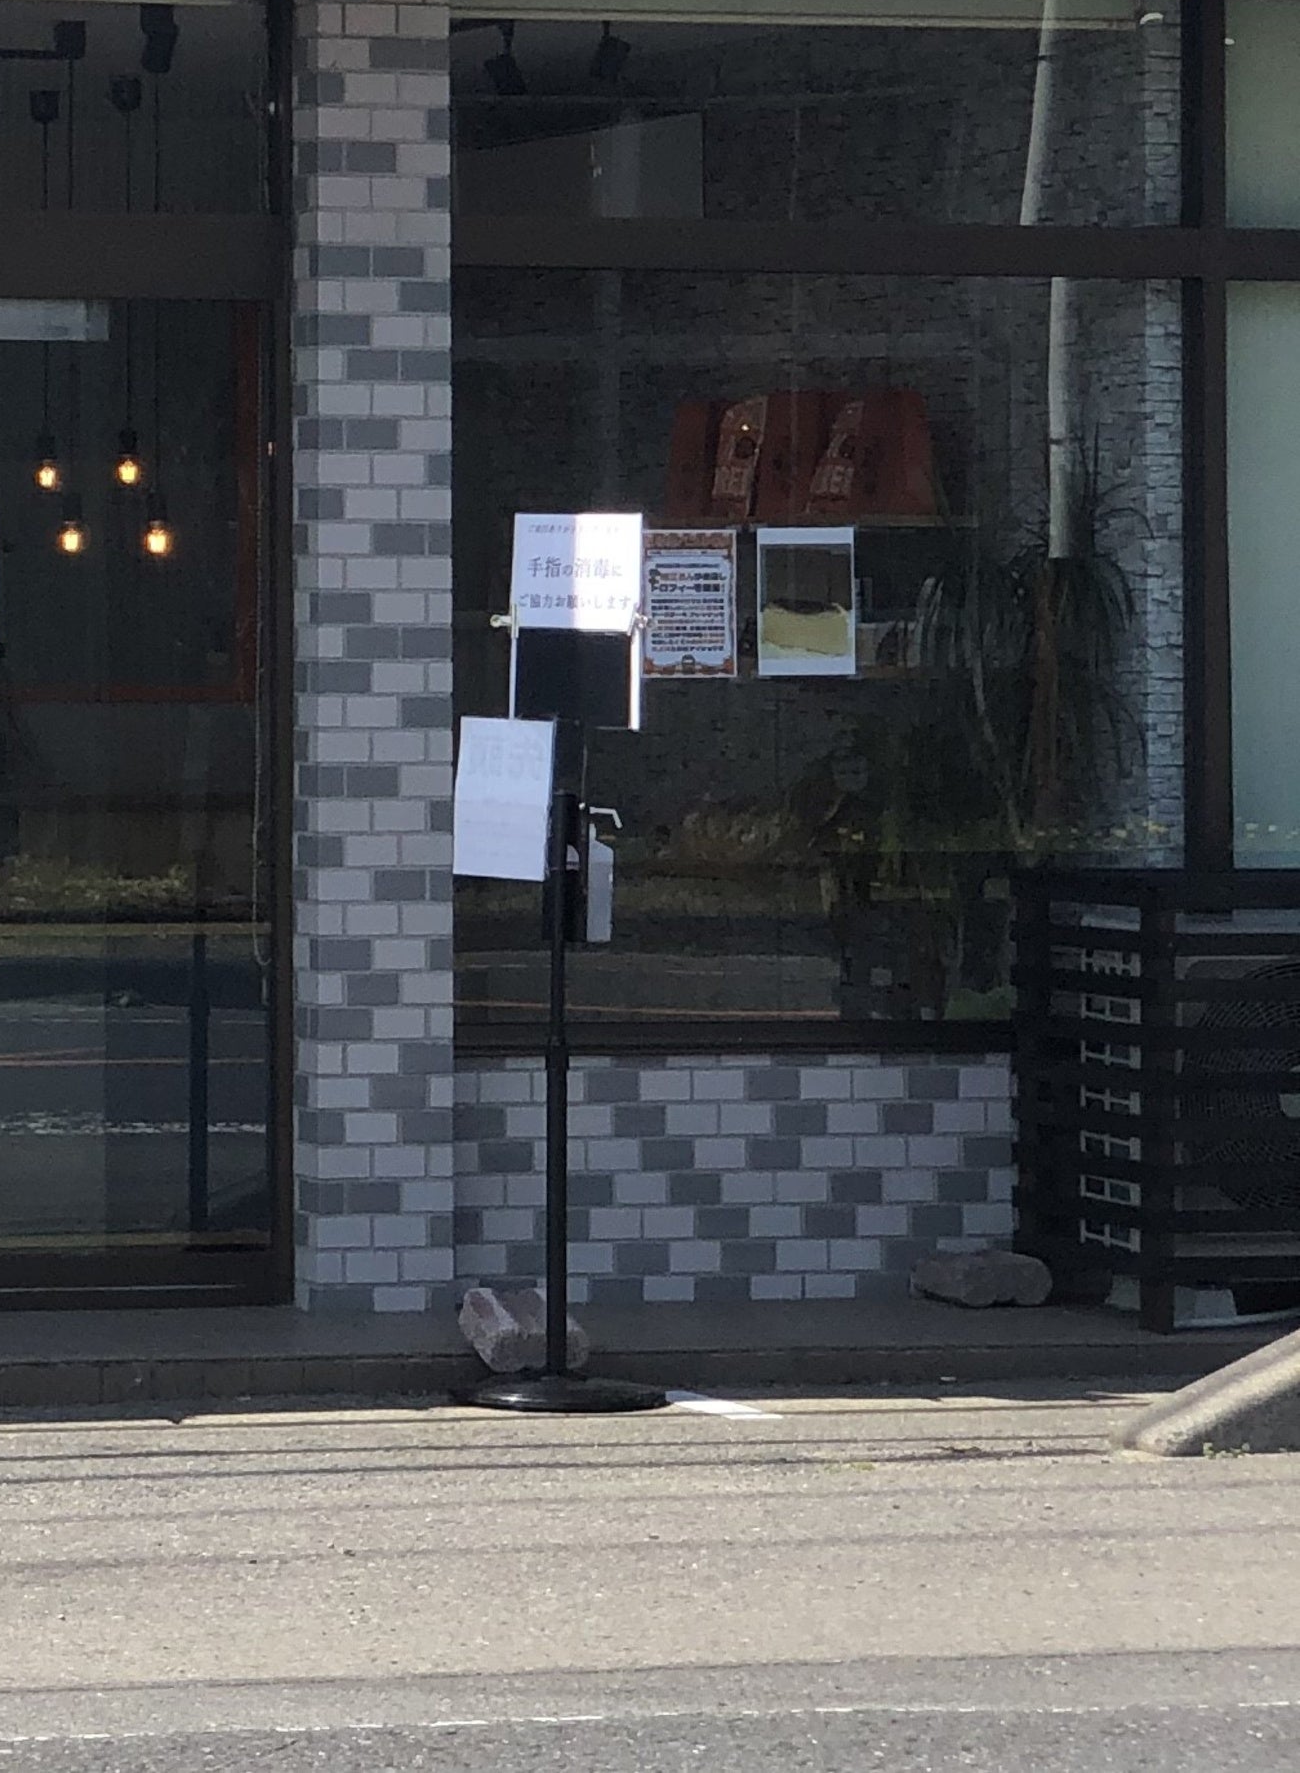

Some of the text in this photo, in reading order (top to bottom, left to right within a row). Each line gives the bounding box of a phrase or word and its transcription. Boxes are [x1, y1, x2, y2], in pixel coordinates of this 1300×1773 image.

[527, 556, 623, 579] 手指の消毒に
[518, 593, 631, 610] ご協力お願いします
